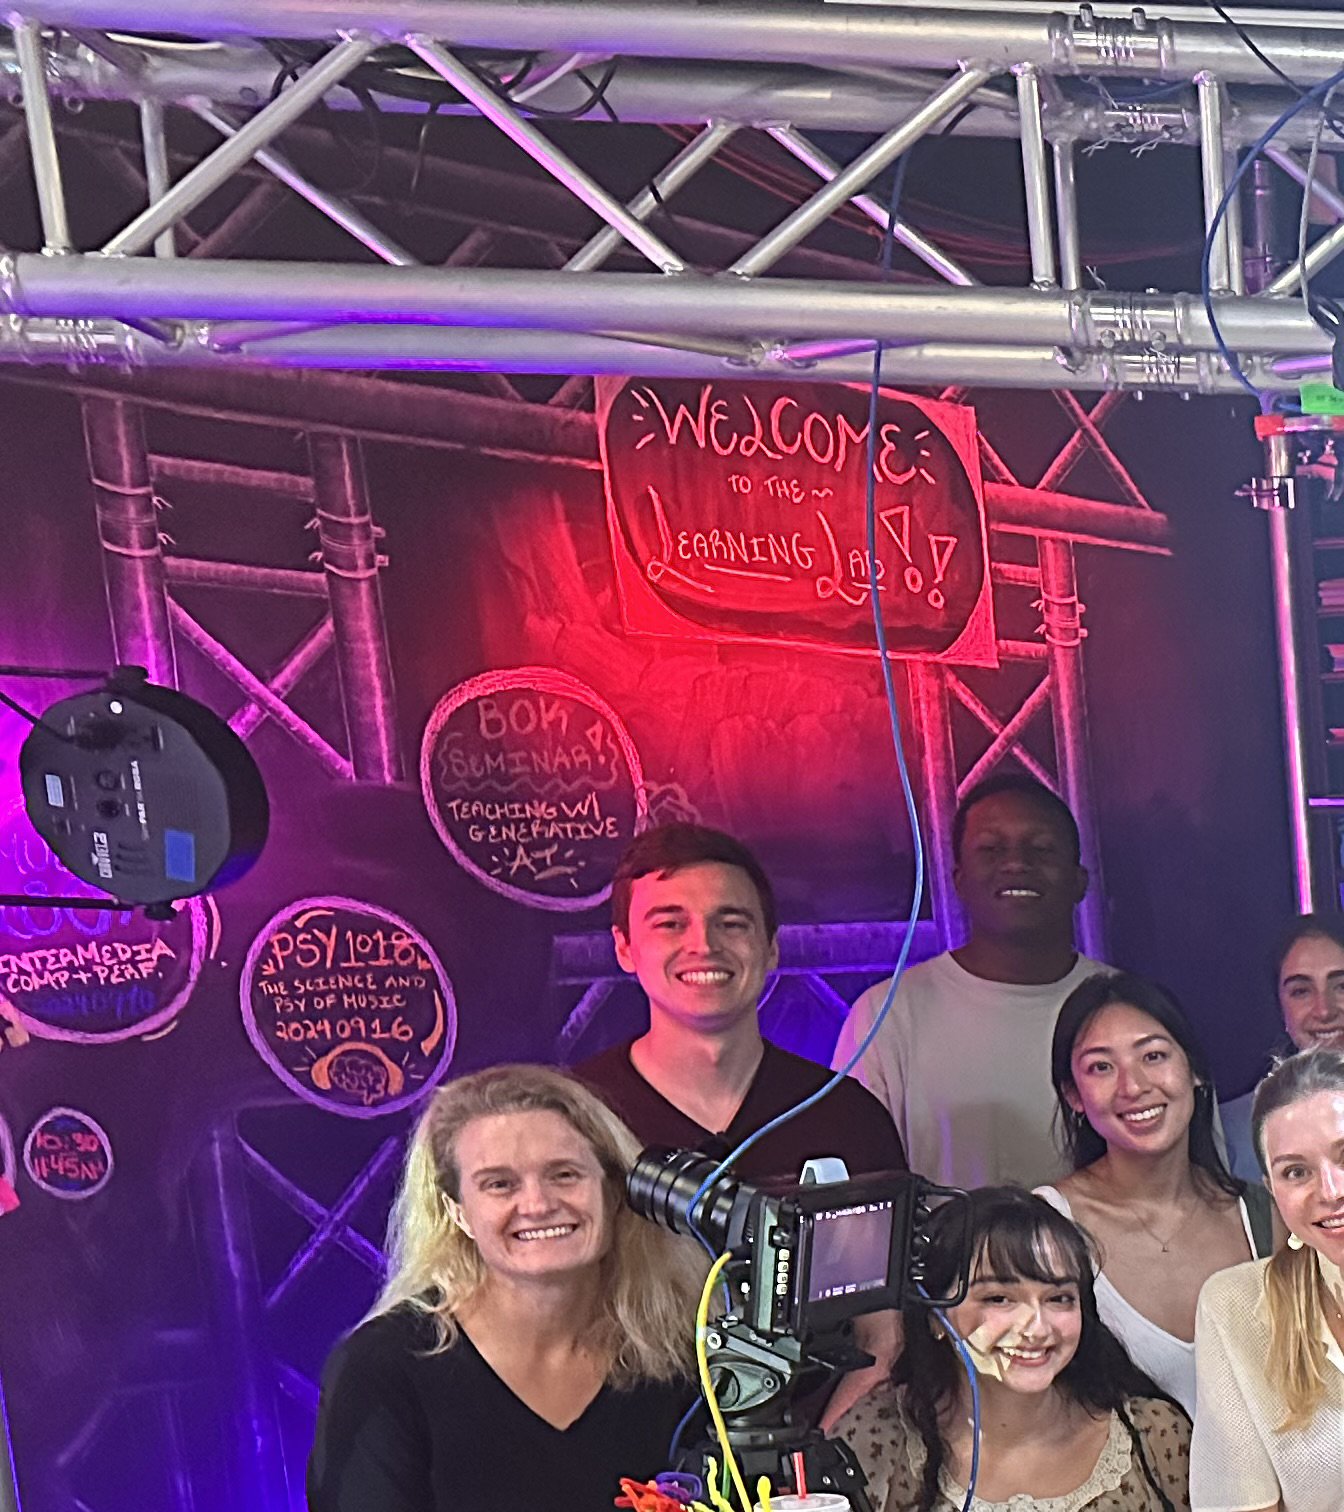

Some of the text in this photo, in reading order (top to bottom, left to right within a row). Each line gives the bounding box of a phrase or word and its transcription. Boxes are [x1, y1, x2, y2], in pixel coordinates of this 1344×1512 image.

[642, 384, 919, 484] WELCOME
[728, 474, 805, 503] TO THE
[646, 485, 816, 592] LEARNING
[478, 697, 570, 740] BOK
[447, 799, 557, 822] TEACHING
[469, 817, 619, 843] GENERATIVE
[0, 937, 176, 976] INTERMEDIA
[269, 924, 338, 970] PSY
[7, 970, 70, 994] COMP
[259, 974, 426, 995] THE SCIENCE AND
[273, 993, 406, 1013] PSY OF MUSIC
